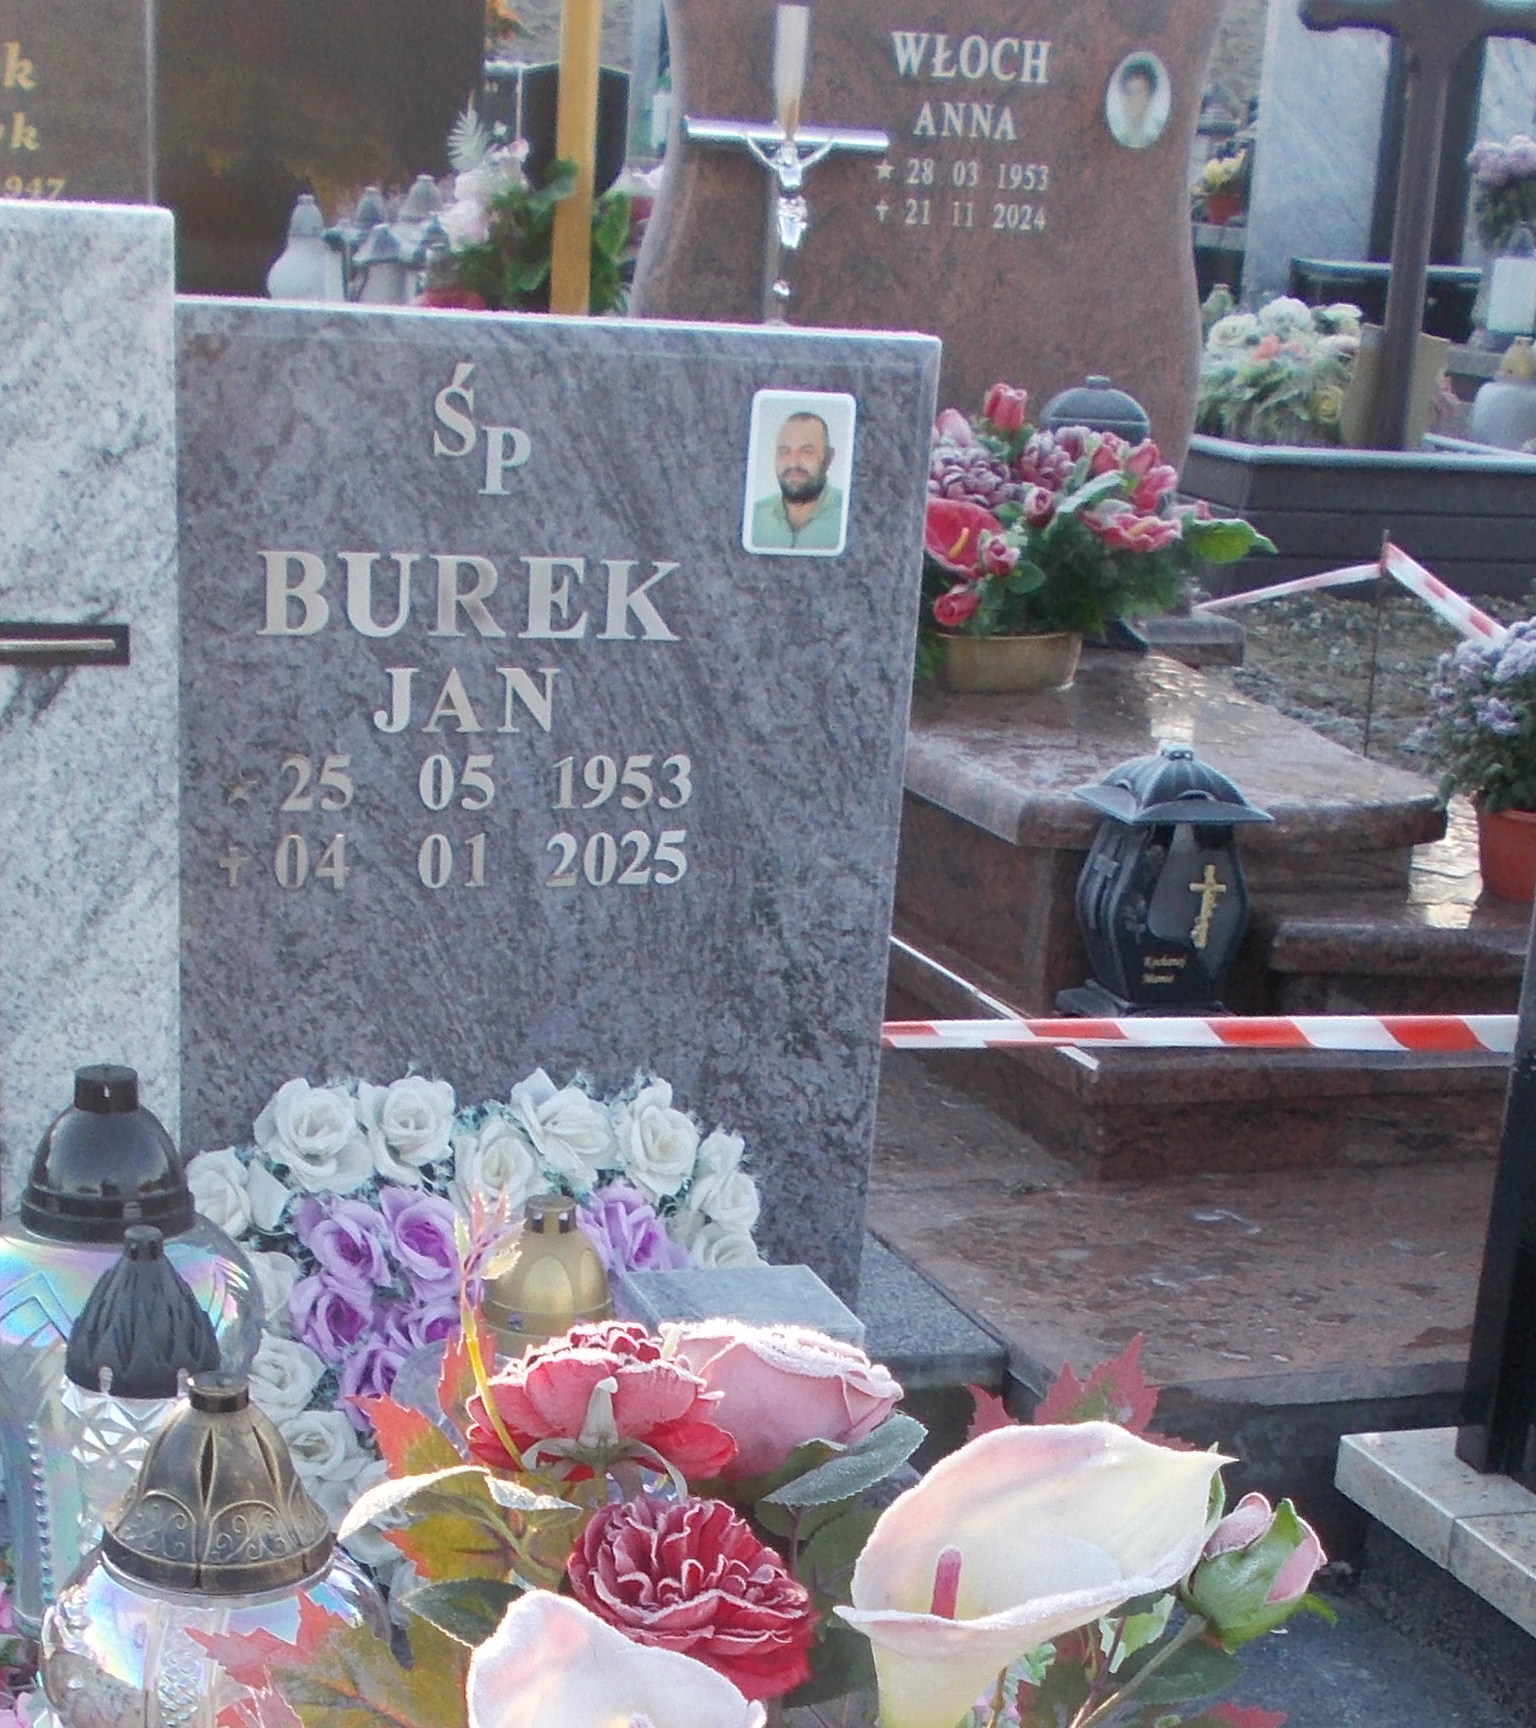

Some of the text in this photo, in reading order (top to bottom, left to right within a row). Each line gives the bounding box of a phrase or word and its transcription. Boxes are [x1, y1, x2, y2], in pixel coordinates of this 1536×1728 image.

[891, 30, 1053, 84] WŁOCH
[913, 102, 1017, 142] ANNA
[906, 158, 1050, 192] 28 03 1953
[904, 199, 1047, 232] 21 11 2024
[256, 549, 682, 642] BUREK
[372, 667, 562, 734] JAN
[279, 752, 694, 812] 25 05 1953
[274, 829, 689, 890] 04 01 2025
